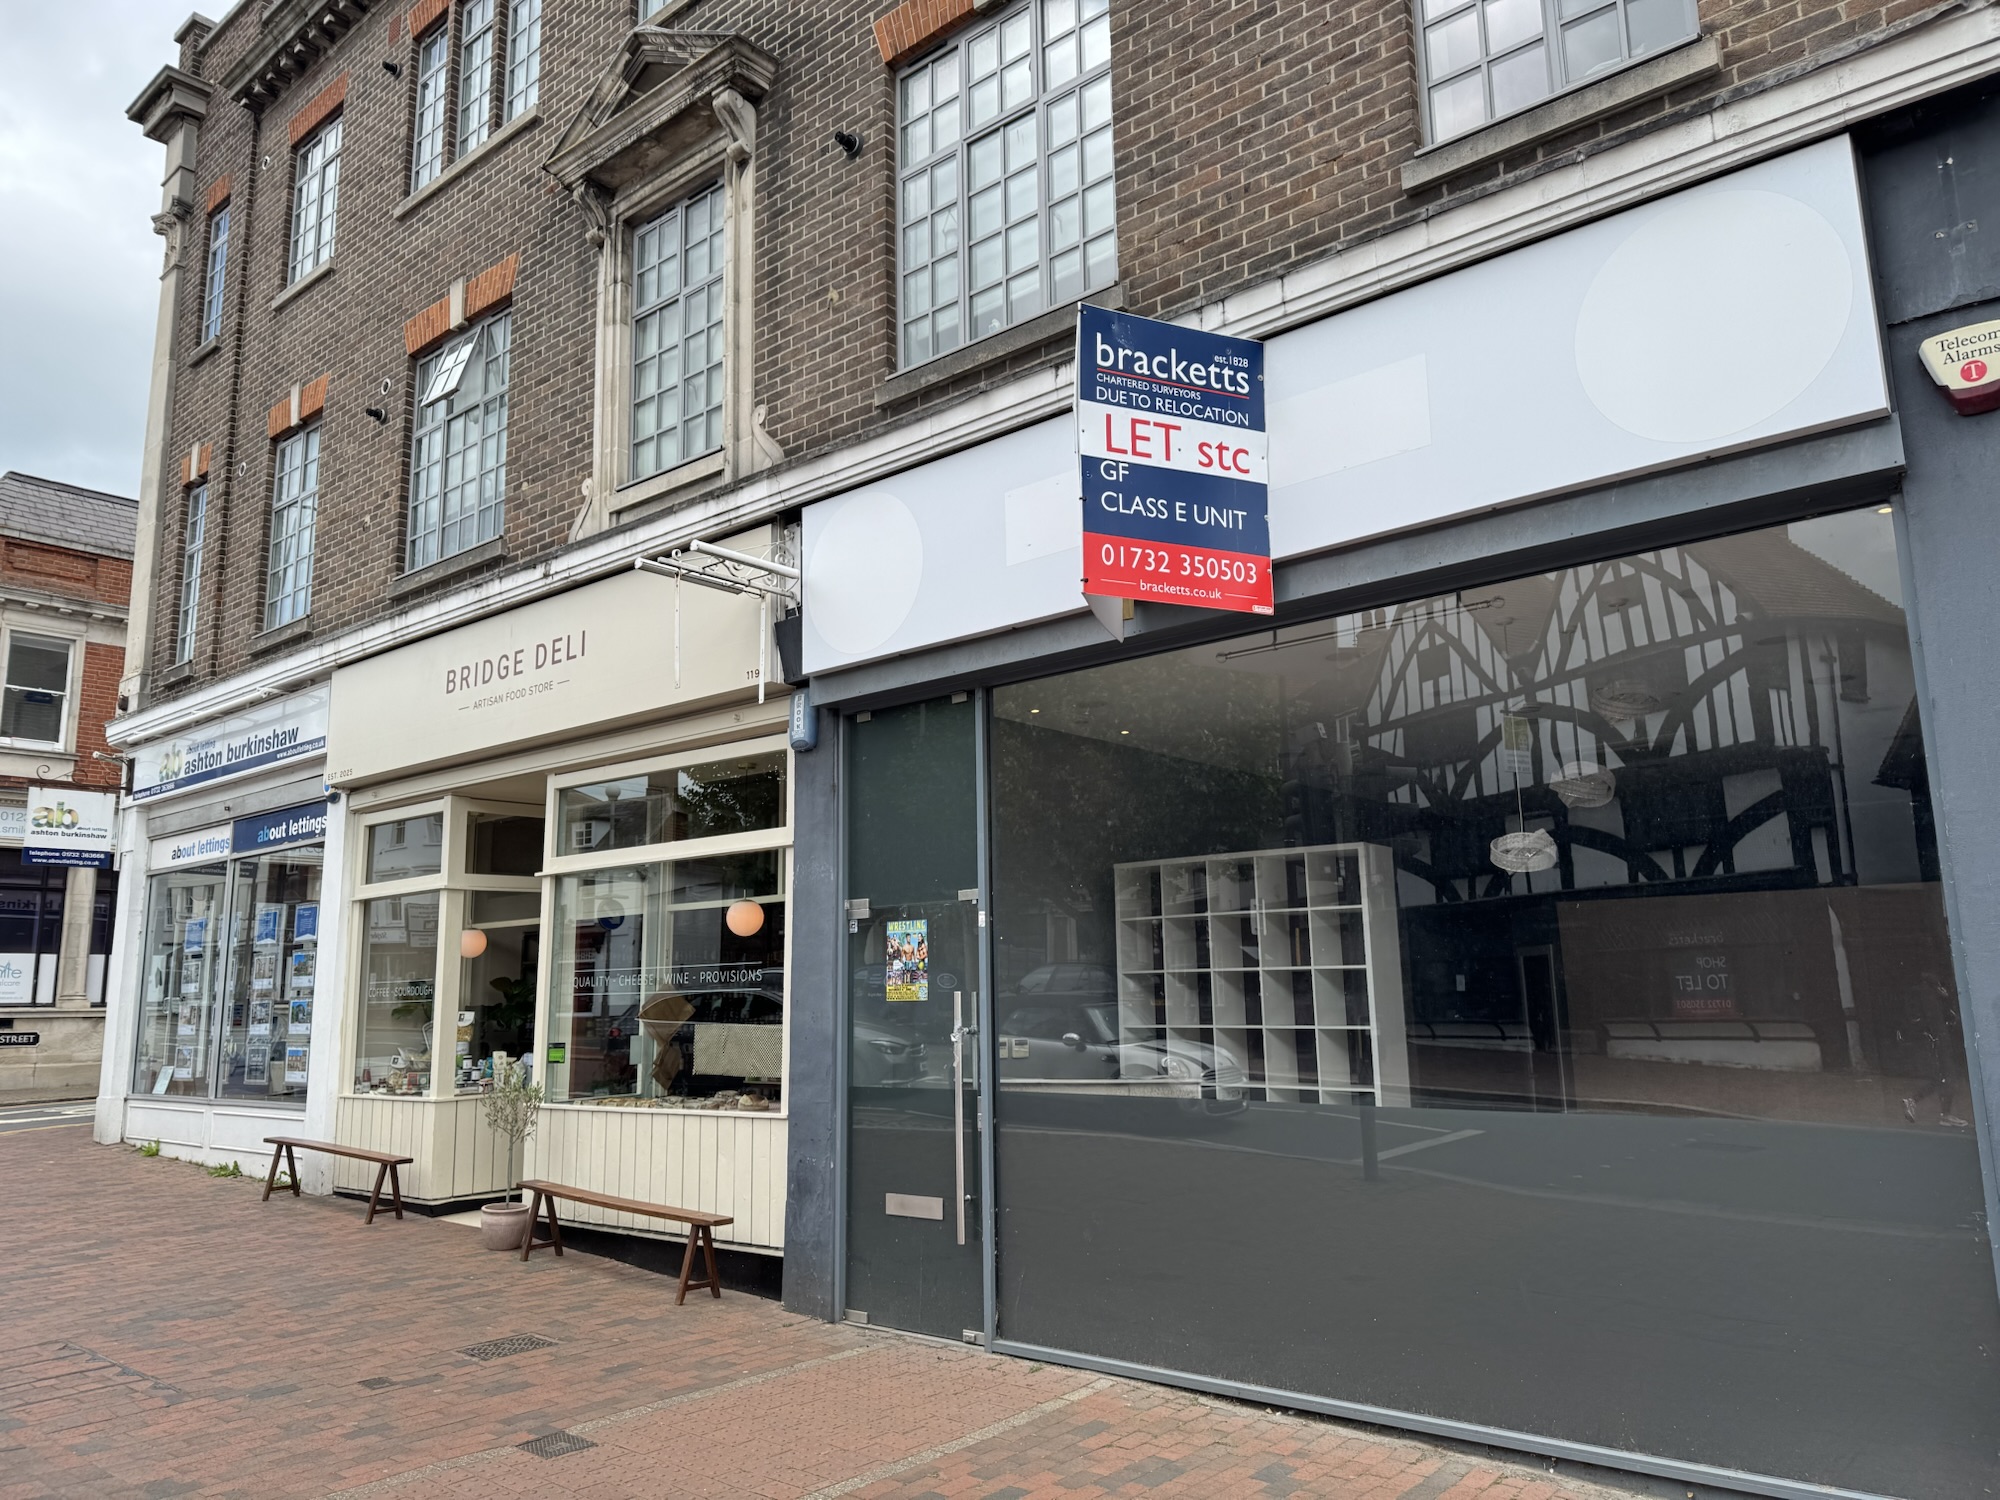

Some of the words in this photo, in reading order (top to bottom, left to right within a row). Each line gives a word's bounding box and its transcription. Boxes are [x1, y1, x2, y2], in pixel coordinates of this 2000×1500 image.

[1096, 332, 1250, 394] bracketts
[1943, 343, 2000, 365] Alarms
[1096, 373, 1150, 391] CHARTERED
[1151, 383, 1201, 400] SURVEYORS
[1096, 386, 1127, 406] DUE
[1130, 392, 1151, 409] TO
[1155, 395, 1249, 427] RELOCATION
[1105, 413, 1181, 462] LET
[1197, 441, 1250, 474] stc
[1100, 461, 1129, 482] GF
[1101, 491, 1167, 520] CLASS
[1175, 502, 1187, 522] E
[1193, 504, 1248, 531] UNIT
[1101, 543, 1171, 574] 01732
[1180, 553, 1257, 584] 350503
[1139, 578, 1223, 600] bracketts.co.uk
[444, 647, 525, 695] BRIDGE
[535, 630, 588, 671] DELI
[746, 668, 760, 680] 119
[473, 693, 504, 710] ARTISAN
[505, 685, 527, 702] FOOD
[528, 679, 554, 698] STORE
[184, 749, 223, 776] ashton
[226, 726, 300, 764] burkinshaw
[30, 829, 59, 837] ashton
[61, 830, 107, 840] burkinshaw
[257, 822, 287, 843] about
[288, 815, 328, 837] lettings
[171, 844, 196, 860] about
[197, 837, 230, 856] lettings
[888, 920, 926, 931] WRESTLING
[368, 987, 390, 998] COFFEE
[394, 984, 433, 997] SOURDOUGH
[573, 975, 611, 989] QUALITY
[618, 973, 654, 987] CHEESE
[662, 971, 690, 985] WINE
[699, 968, 763, 984] PROVISIONS
[0, 1034, 36, 1044] STREET
